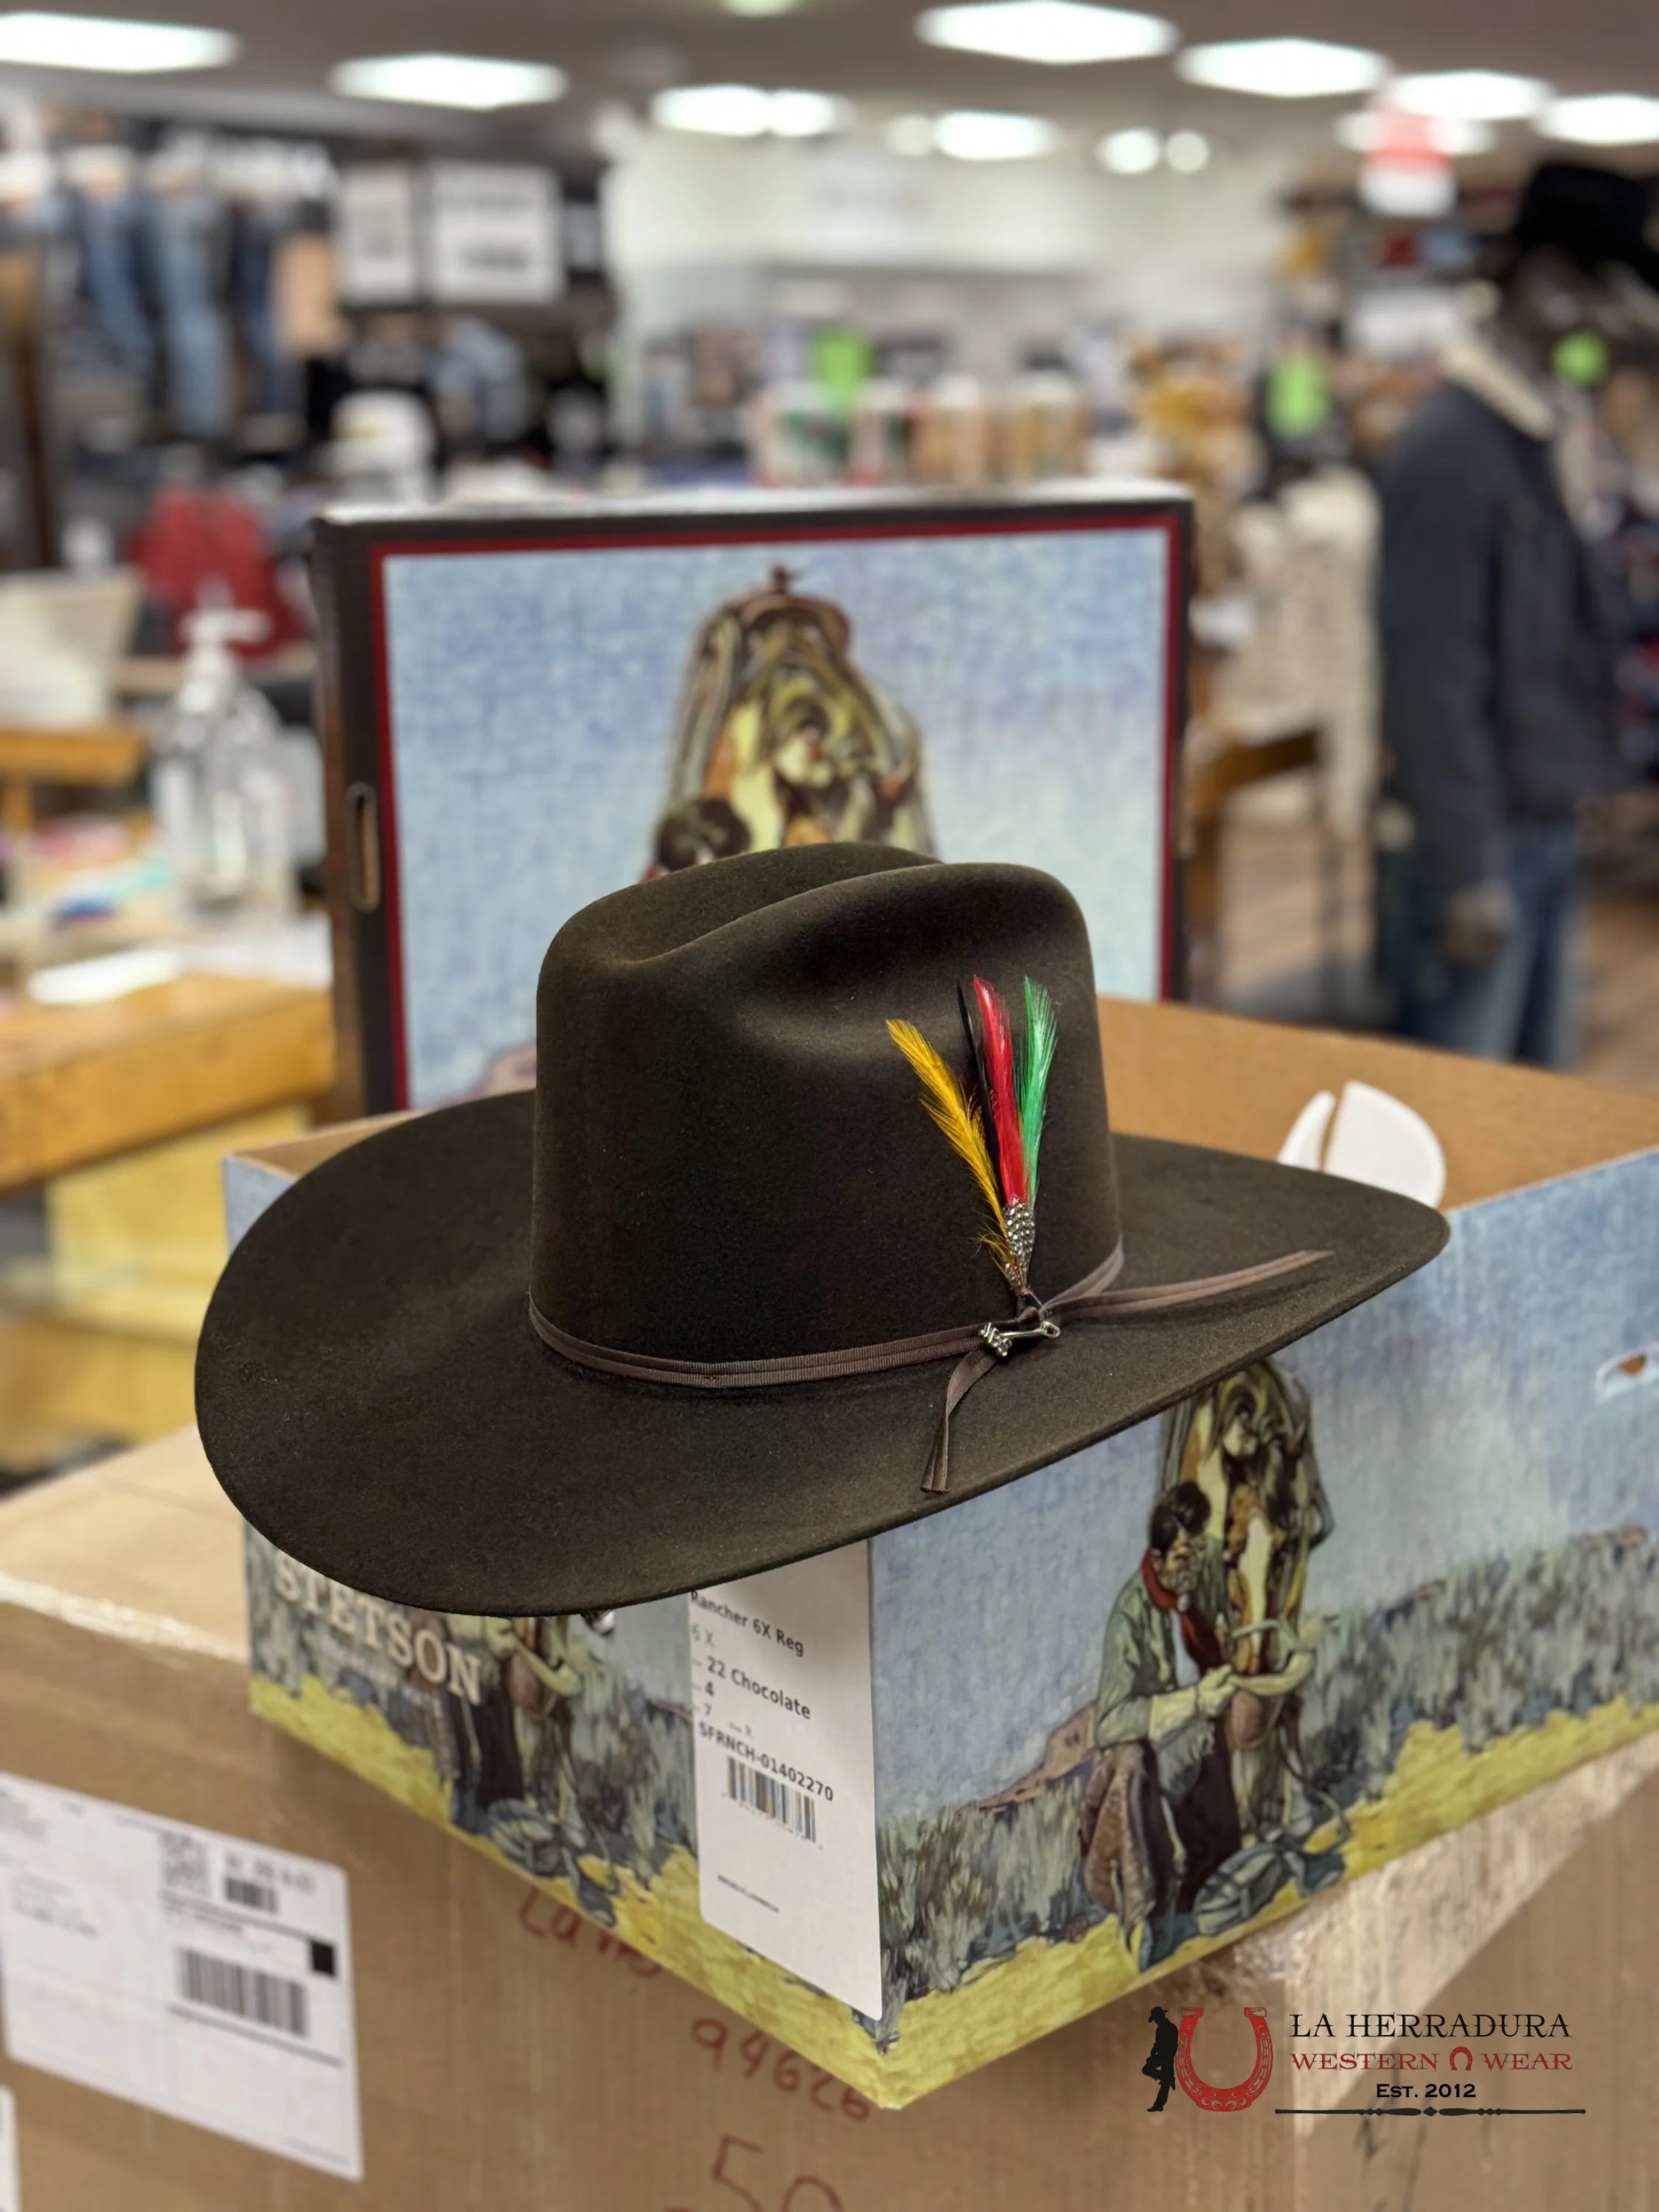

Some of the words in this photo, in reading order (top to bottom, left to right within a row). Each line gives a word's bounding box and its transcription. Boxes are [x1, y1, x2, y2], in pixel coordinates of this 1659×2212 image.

[274, 1551, 481, 1705] STETSON
[691, 1590, 748, 1628] Rancher
[753, 1618, 771, 1640] 6X
[776, 1627, 804, 1658] Reg
[704, 1680, 714, 1697] 4
[707, 1655, 726, 1679] 22
[730, 1668, 812, 1720] Chocolate
[698, 1721, 835, 1802] SFRNCH-01402270
